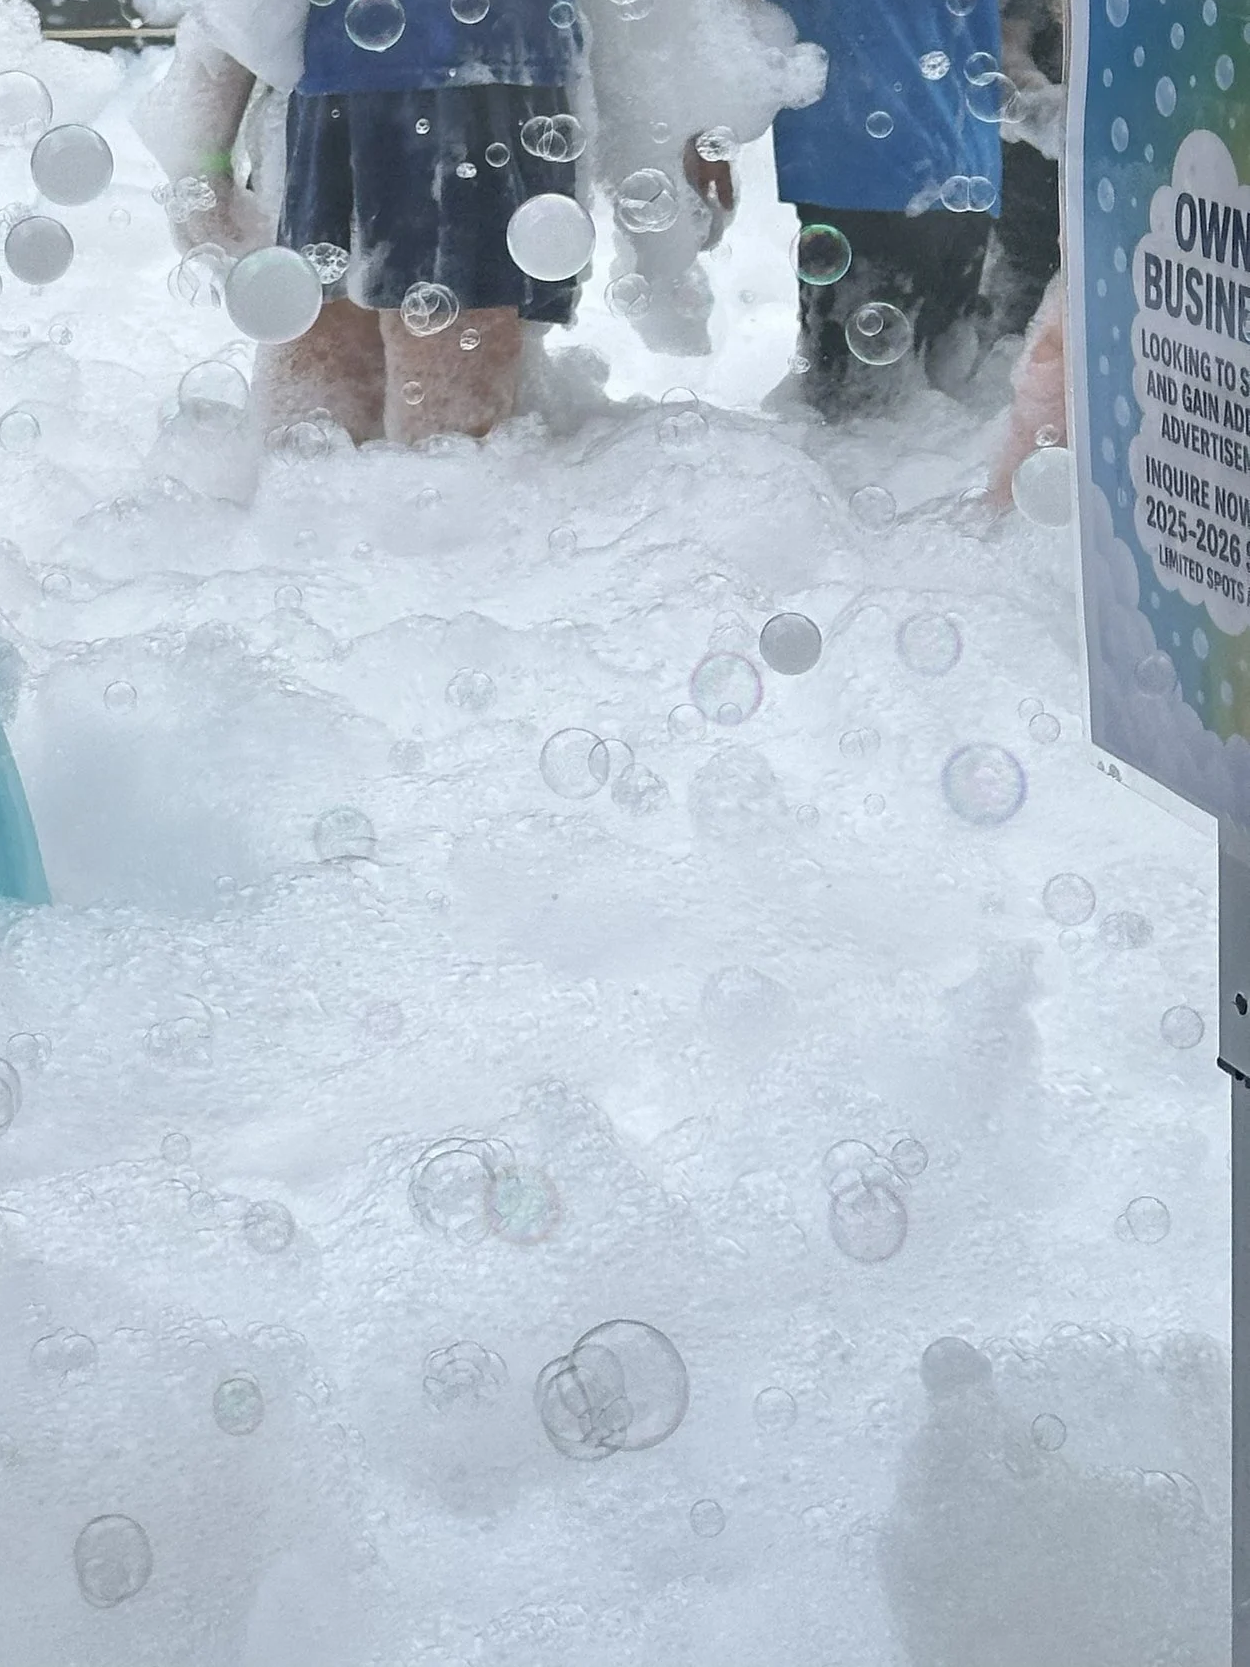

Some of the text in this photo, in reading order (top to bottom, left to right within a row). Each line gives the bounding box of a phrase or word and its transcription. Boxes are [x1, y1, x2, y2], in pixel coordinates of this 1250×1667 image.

[1175, 192, 1250, 273] OWN
[1141, 327, 1211, 383] LOOKING
[1215, 356, 1236, 392] TO
[1147, 369, 1178, 406] AND
[1182, 383, 1220, 424] GAIN
[1146, 454, 1210, 510] INQUIRE
[1146, 494, 1241, 568] 2025-2026
[1159, 543, 1204, 584] LIMITED
[1206, 567, 1244, 604] SPOTS
